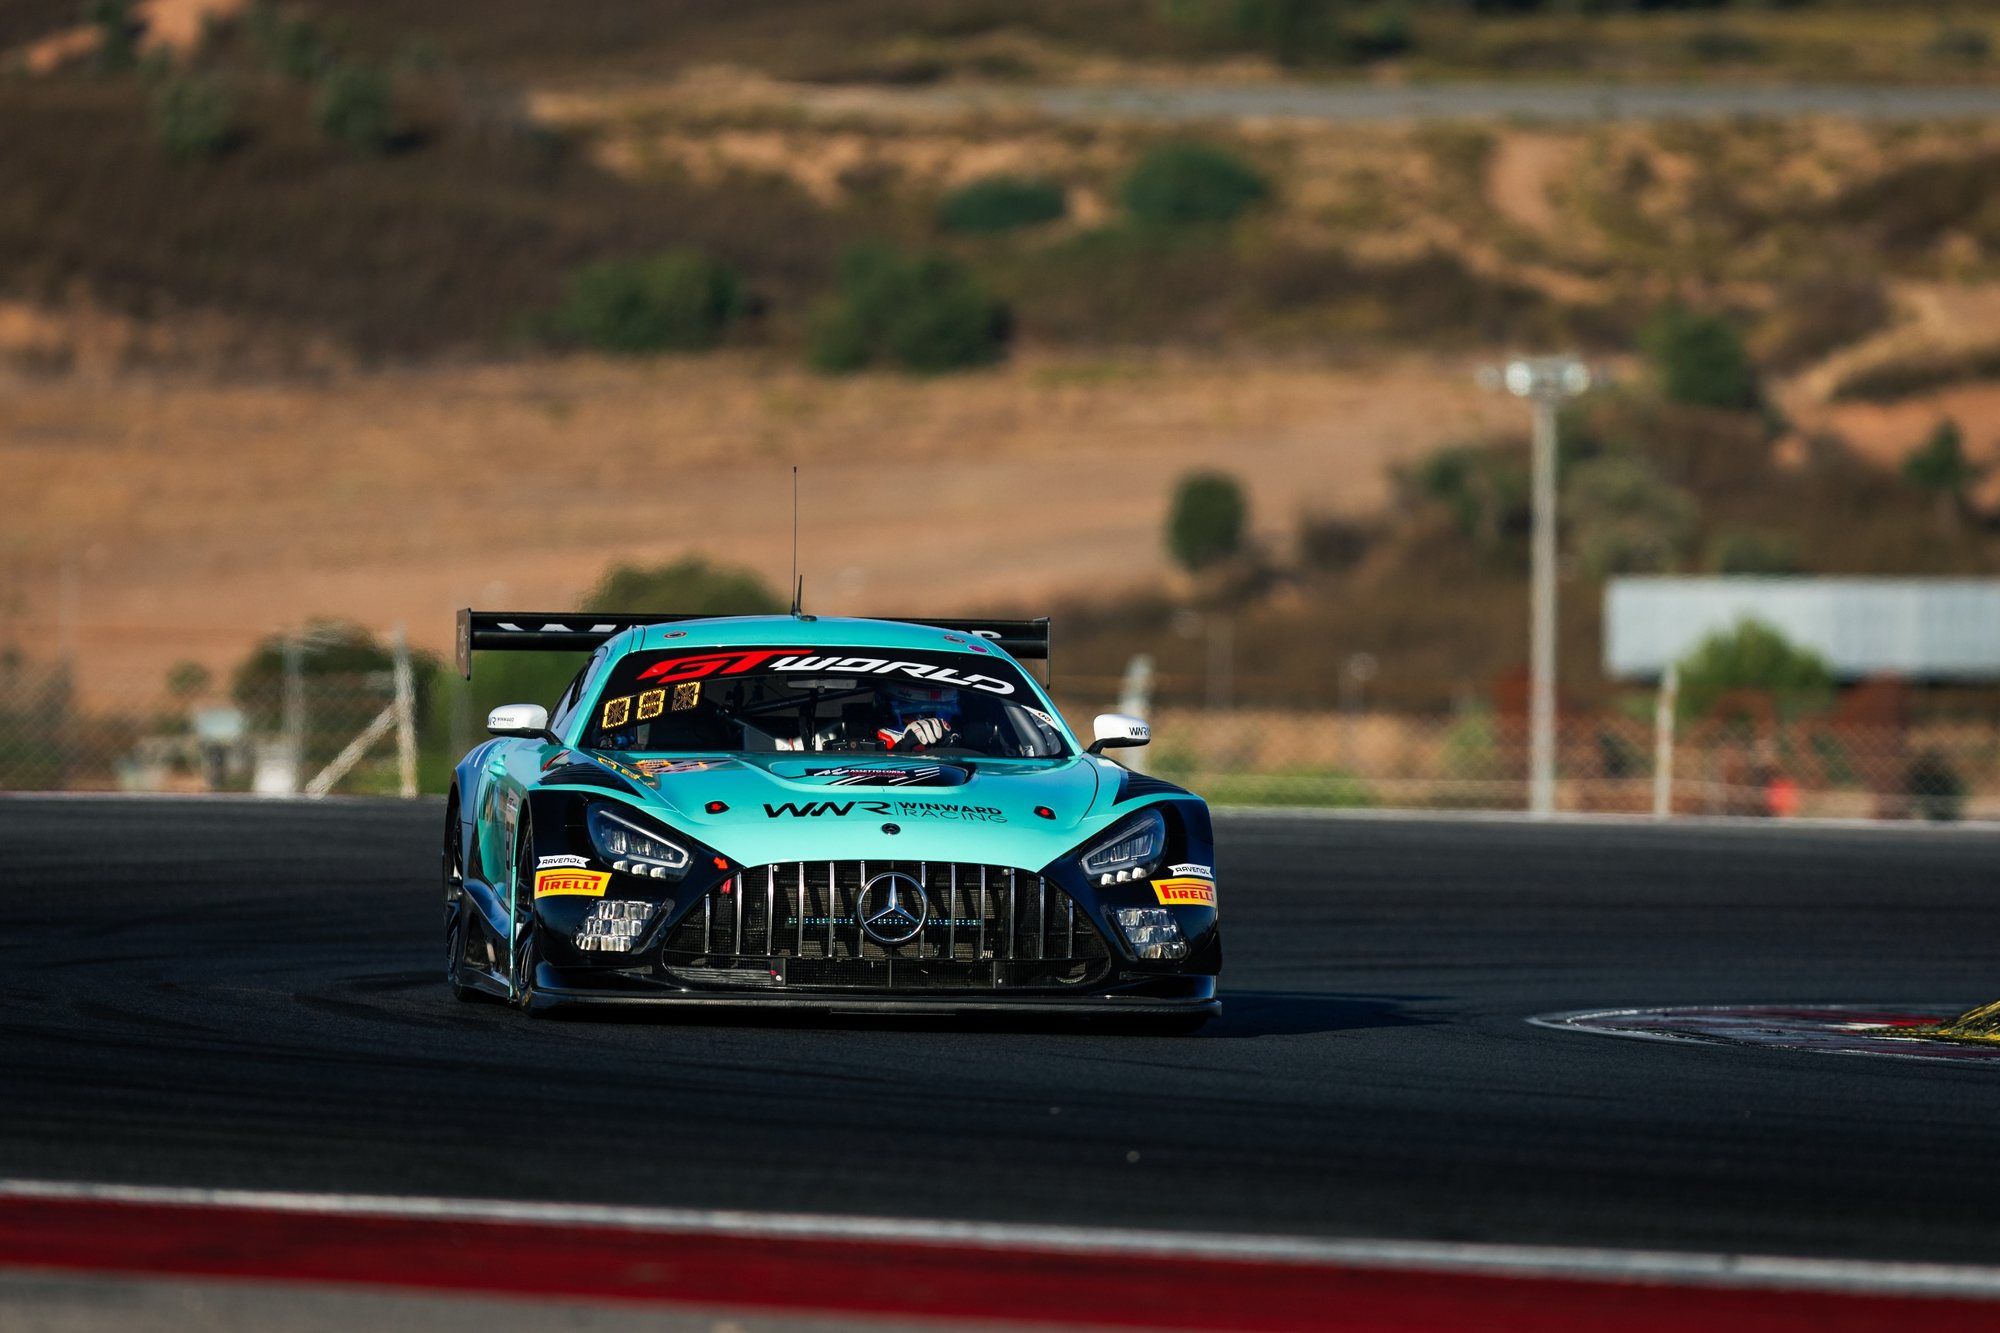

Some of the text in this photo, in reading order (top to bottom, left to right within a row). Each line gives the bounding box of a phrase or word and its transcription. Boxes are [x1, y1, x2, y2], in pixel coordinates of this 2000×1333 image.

[637, 649, 1014, 694] GT WORLD
[898, 801, 1002, 815] WINWARD
[901, 808, 1008, 823] RACING
[542, 857, 582, 865] RAVENOL
[1175, 866, 1210, 875] RAVENOL
[538, 874, 602, 892] PIRELLI
[1160, 884, 1215, 902] PIRELLI
